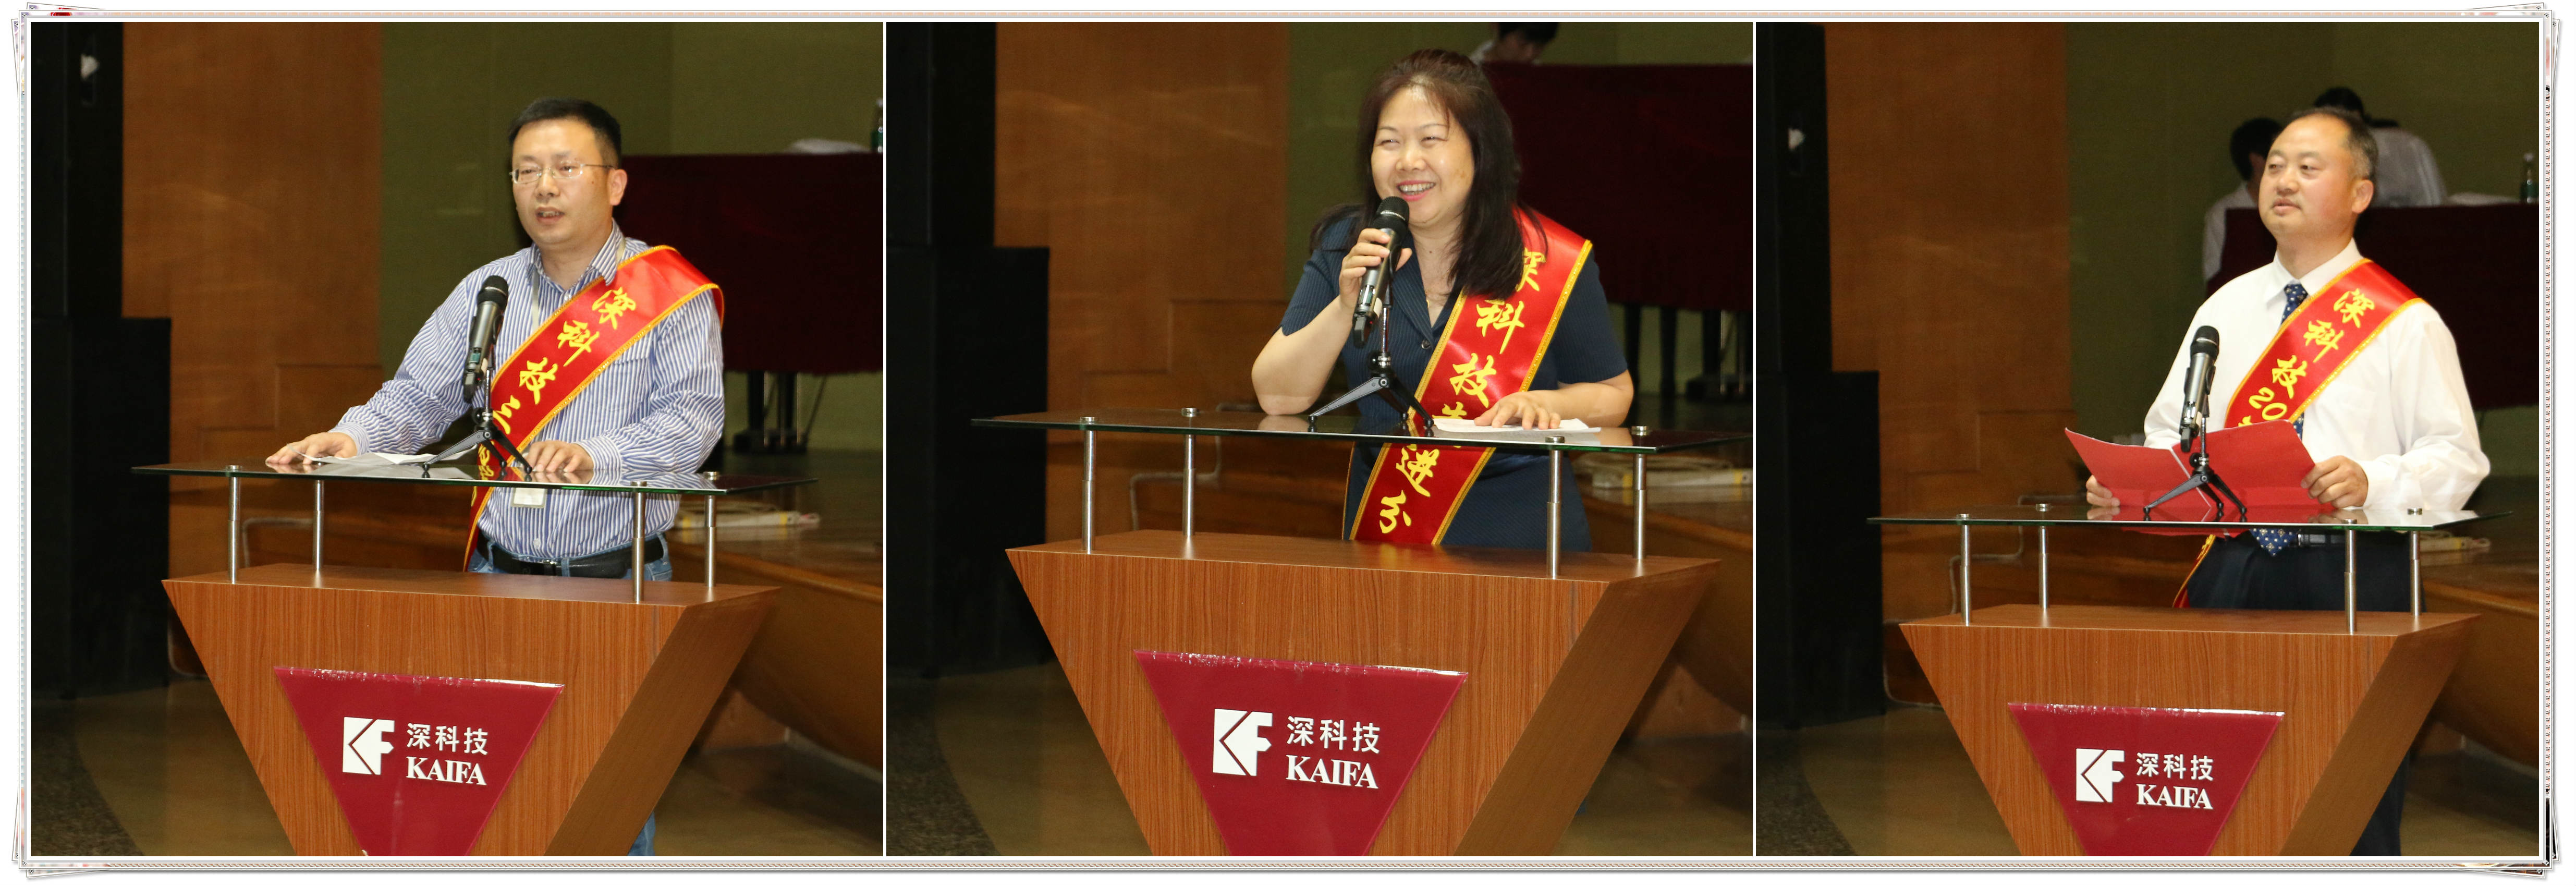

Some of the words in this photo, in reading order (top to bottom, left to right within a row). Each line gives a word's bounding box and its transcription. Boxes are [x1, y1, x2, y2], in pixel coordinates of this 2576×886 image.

[2238, 288, 2375, 428] 深科技20
[406, 722, 489, 755] 深科技
[1287, 715, 1381, 754] 深科技
[406, 756, 487, 785] KAIFA
[1286, 755, 1379, 789] KAIFA
[2136, 752, 2214, 781] 深科技
[2136, 784, 2213, 810] KAIFA
